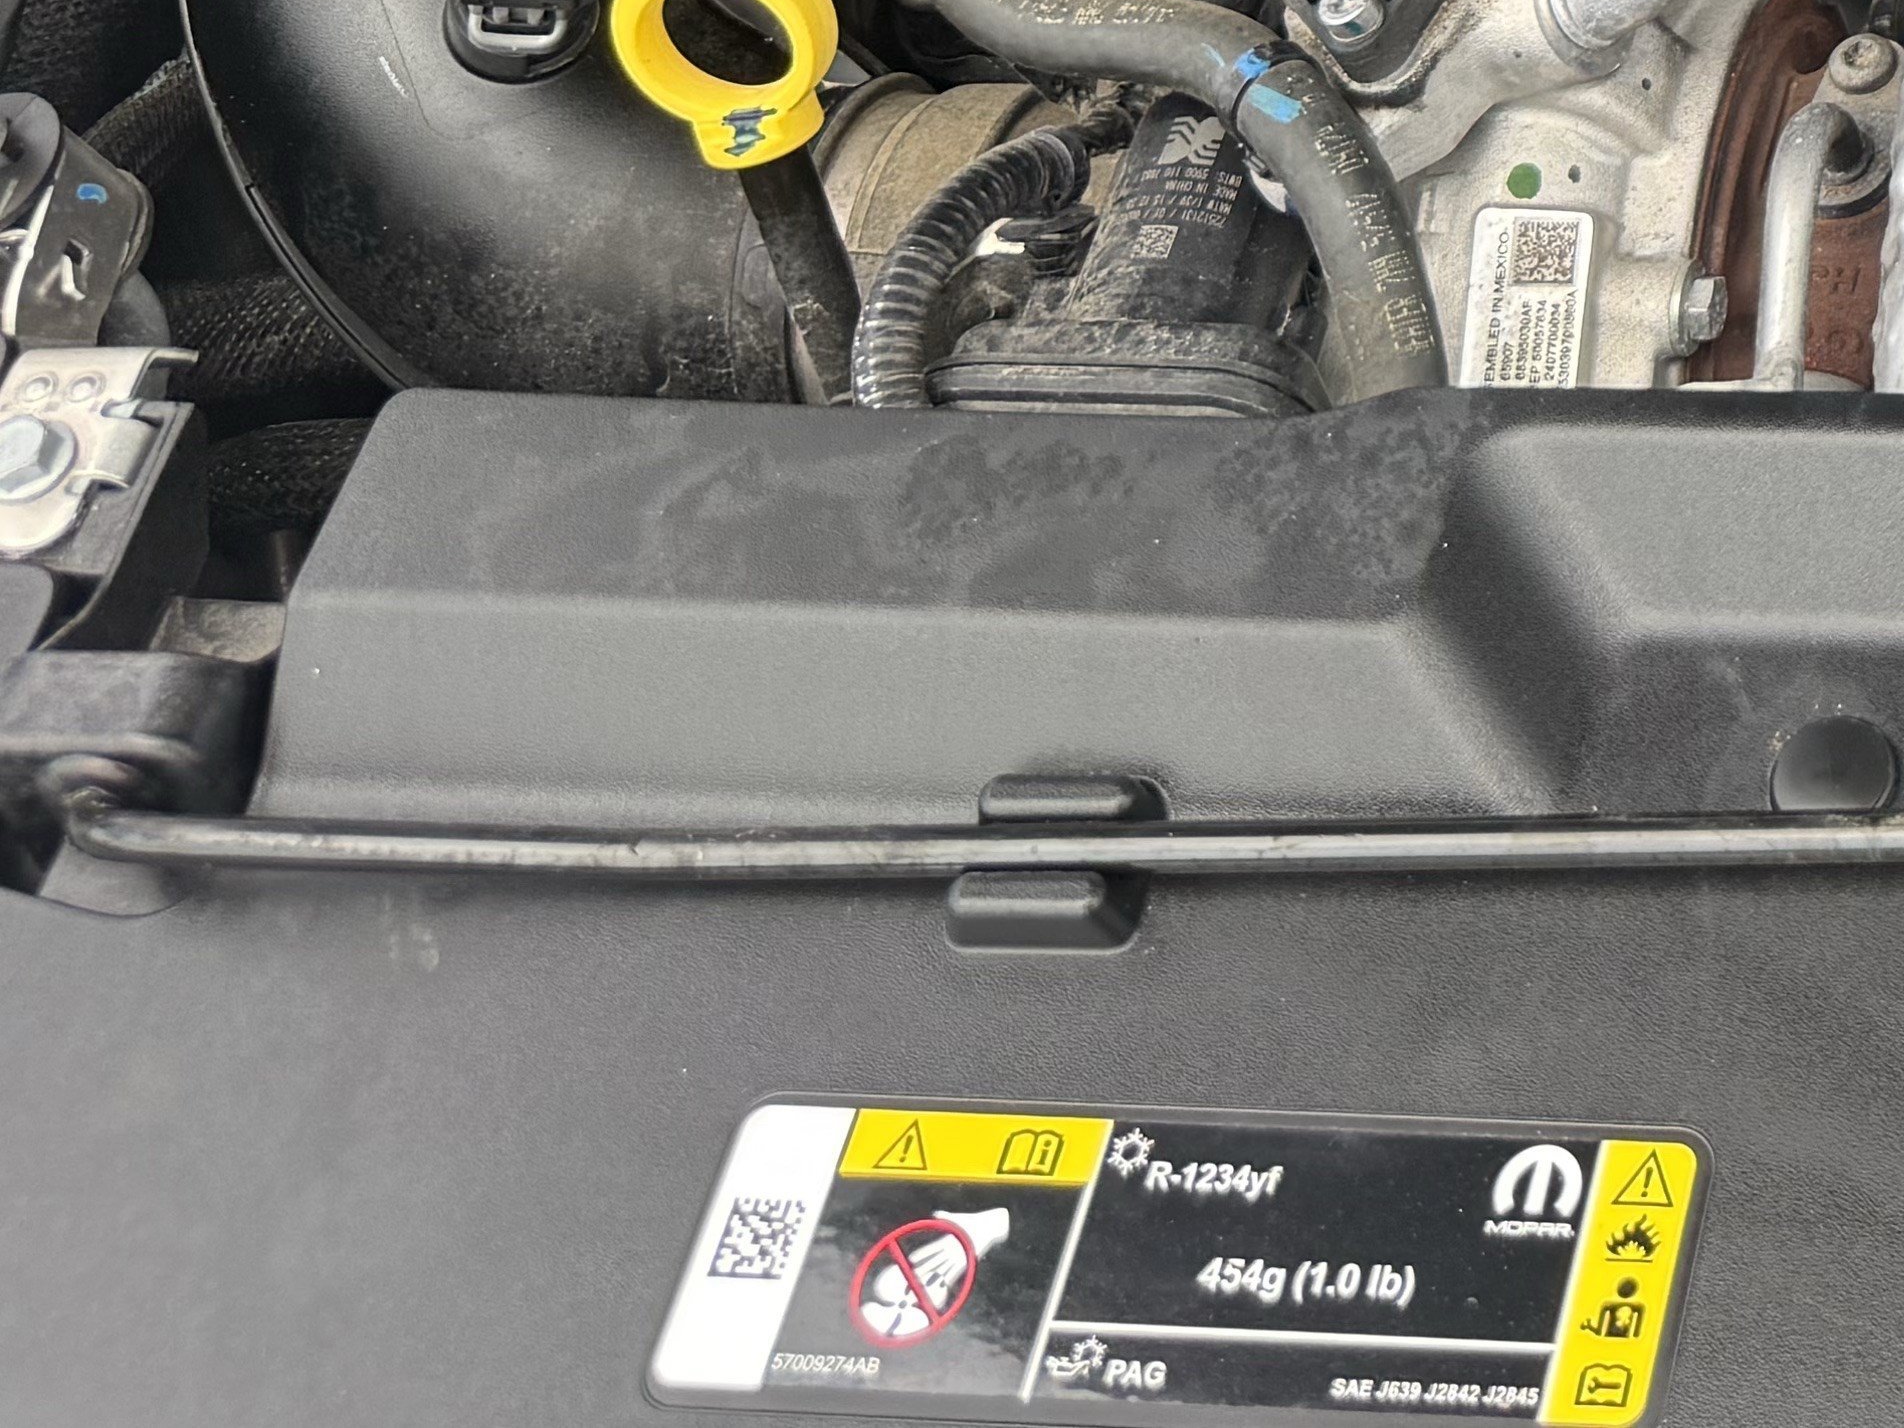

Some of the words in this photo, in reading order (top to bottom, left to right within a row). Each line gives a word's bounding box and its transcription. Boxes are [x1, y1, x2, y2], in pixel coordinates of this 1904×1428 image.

[1195, 182, 1209, 194] IN
[1491, 297, 1502, 312] IN
[1144, 1160, 1284, 1204] R-1234yf
[1482, 1218, 1574, 1240] MOPAR
[1196, 1256, 1288, 1308] 454g
[1292, 1259, 1361, 1306] (1.0
[1365, 1263, 1416, 1311] lb)
[771, 1352, 879, 1376] 57009274AB
[1102, 1357, 1168, 1392] PAG
[1329, 1377, 1375, 1401] SAE
[1374, 1379, 1423, 1404] J639
[1423, 1382, 1481, 1407] J2842
[1480, 1384, 1540, 1410] J2845
